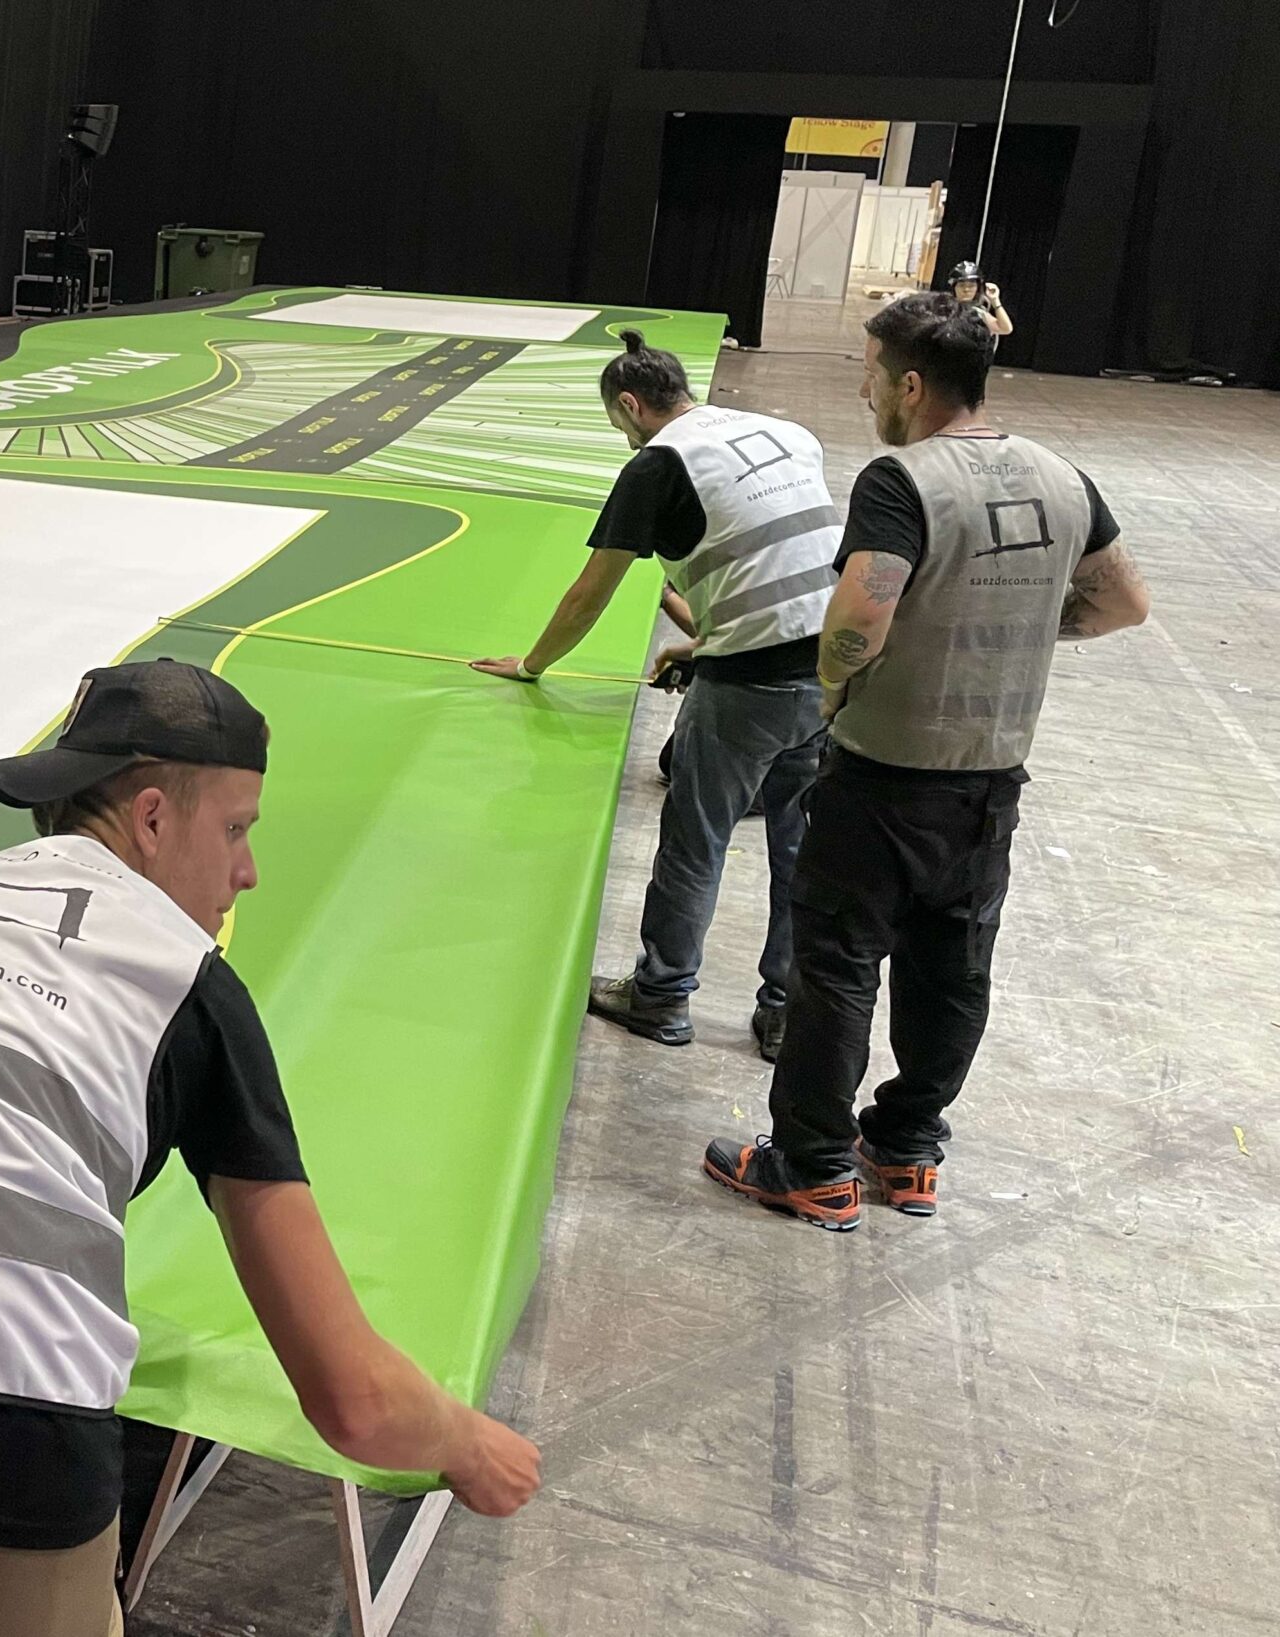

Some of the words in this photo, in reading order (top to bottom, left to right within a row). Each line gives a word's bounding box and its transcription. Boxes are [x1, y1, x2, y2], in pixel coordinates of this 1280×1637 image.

[968, 462, 1001, 475] Deco
[1003, 463, 1039, 476] Team
[746, 478, 813, 502] saezdecom.com
